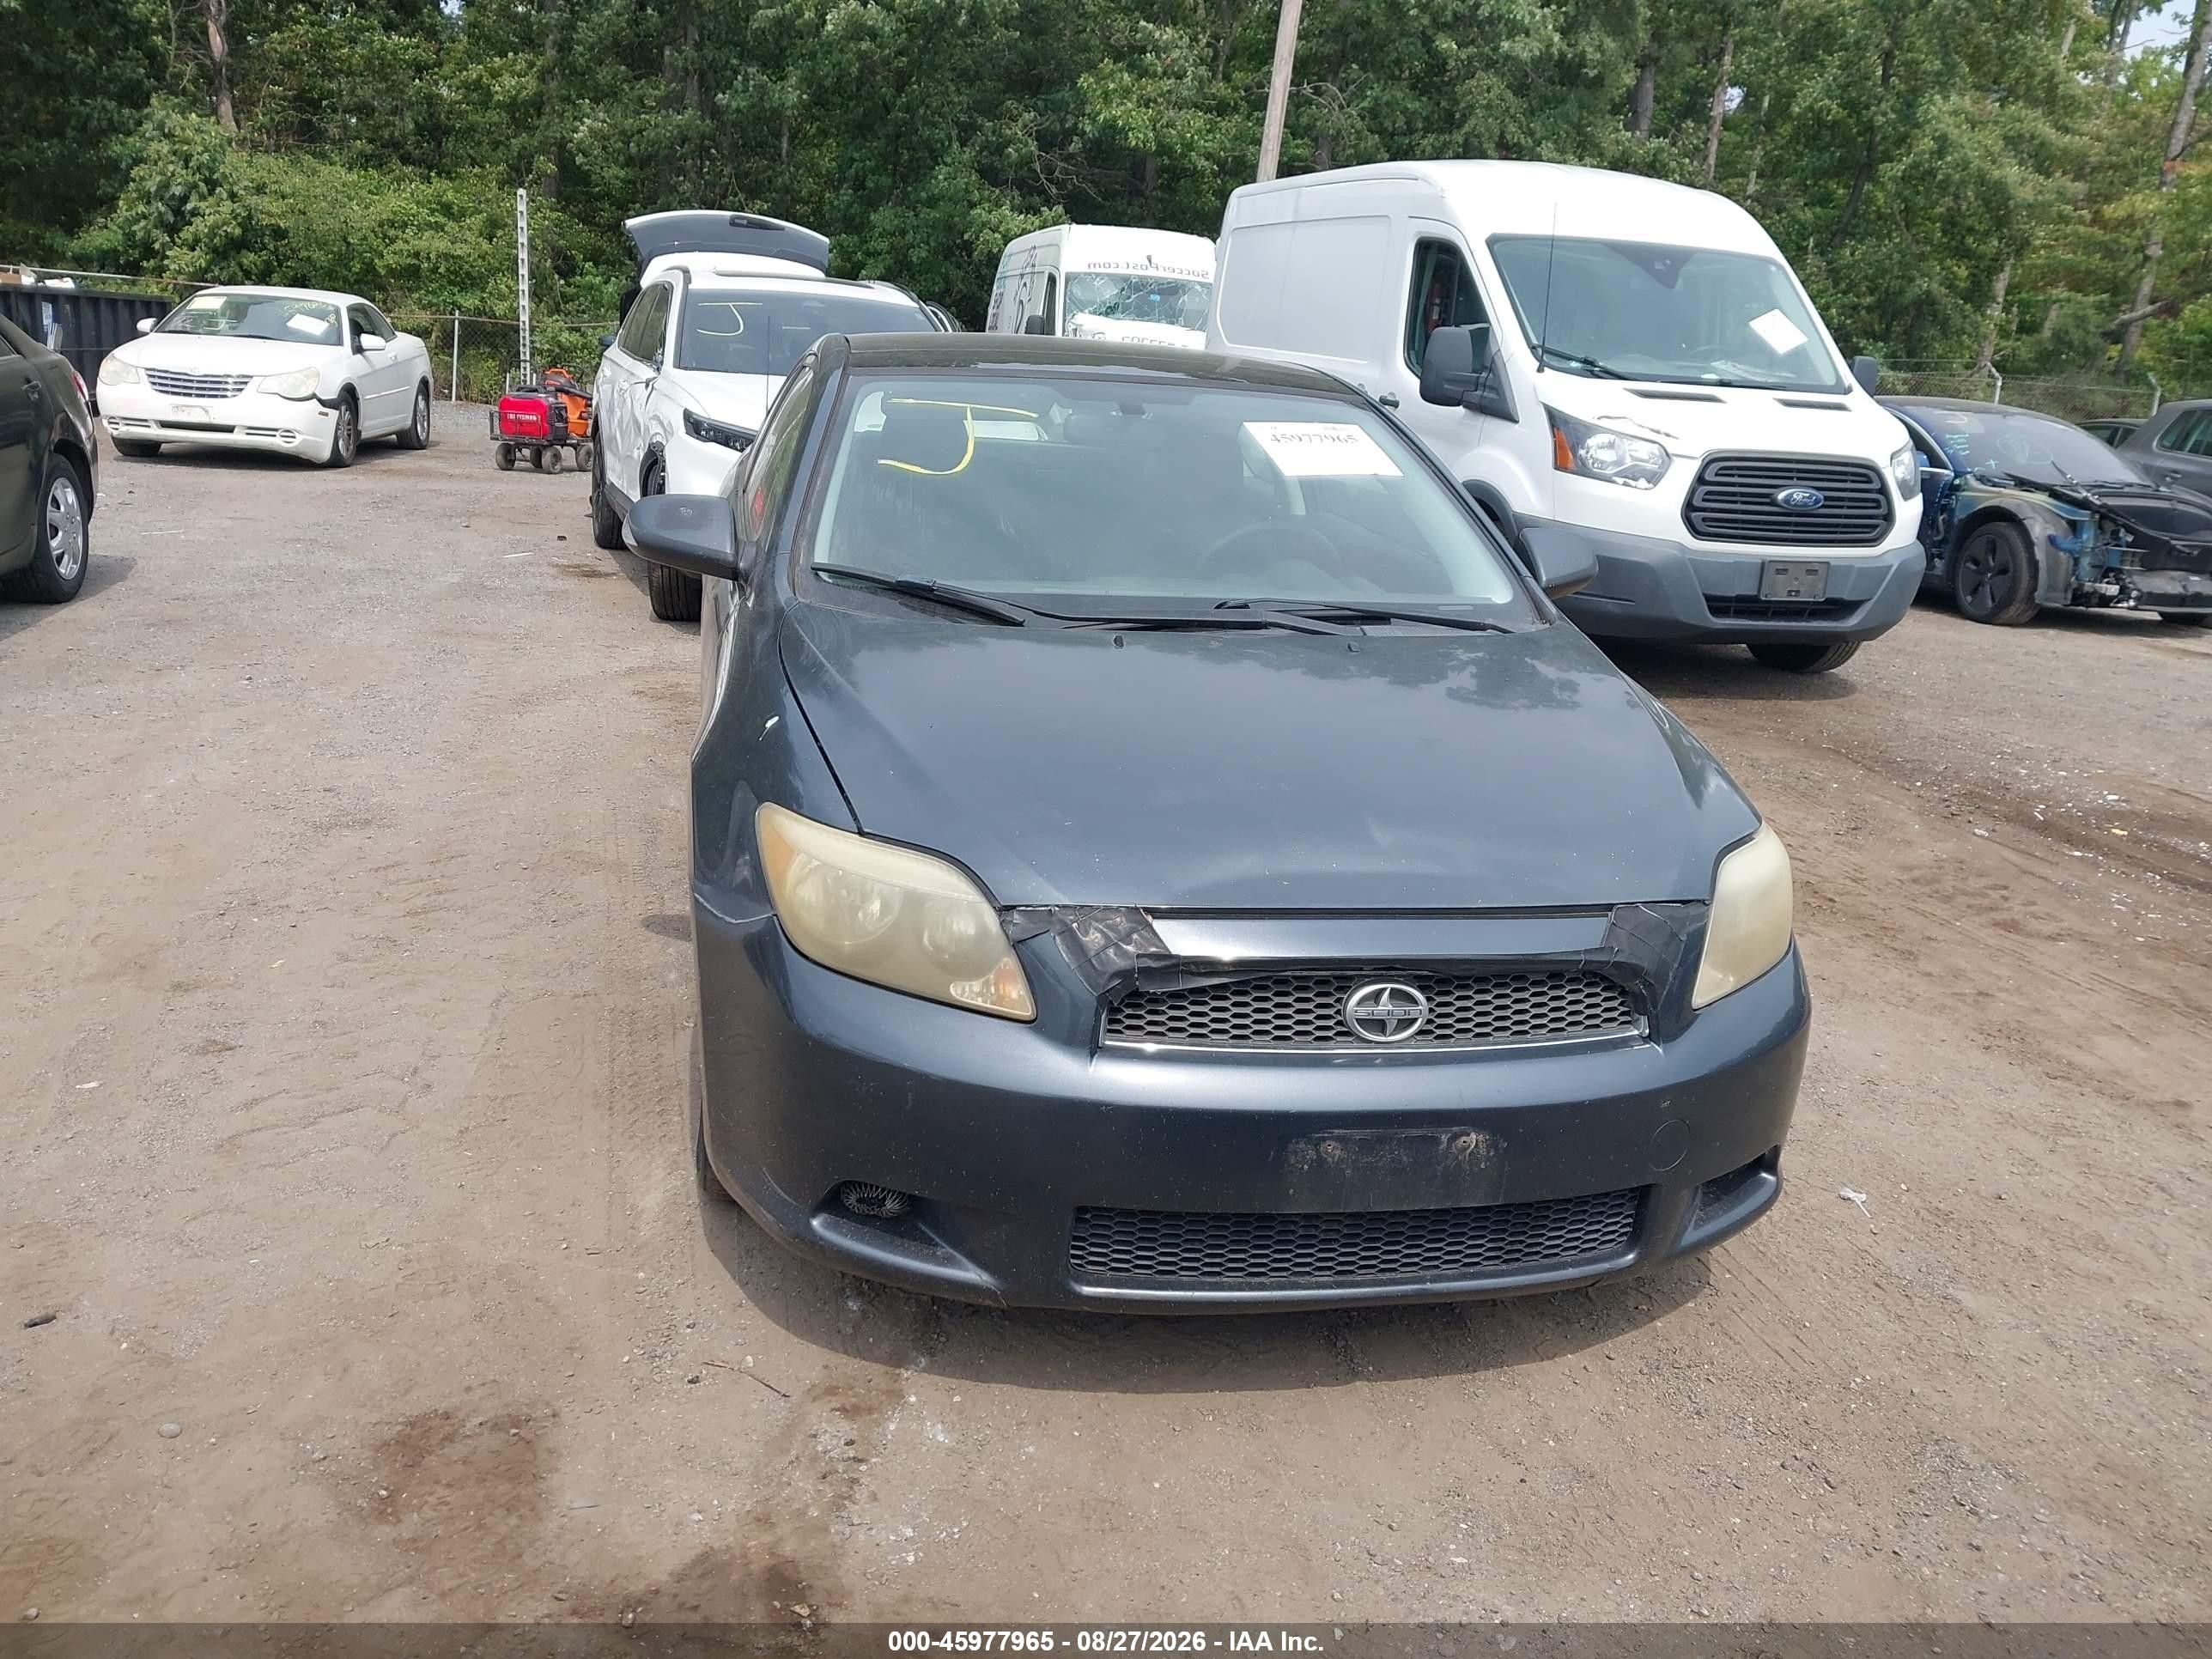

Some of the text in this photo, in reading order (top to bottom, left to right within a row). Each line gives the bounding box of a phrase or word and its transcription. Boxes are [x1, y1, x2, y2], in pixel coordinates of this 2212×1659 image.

[878, 398, 1040, 476] J
[1270, 433, 1358, 444] 45977965
[1790, 491, 1816, 505] Ford
